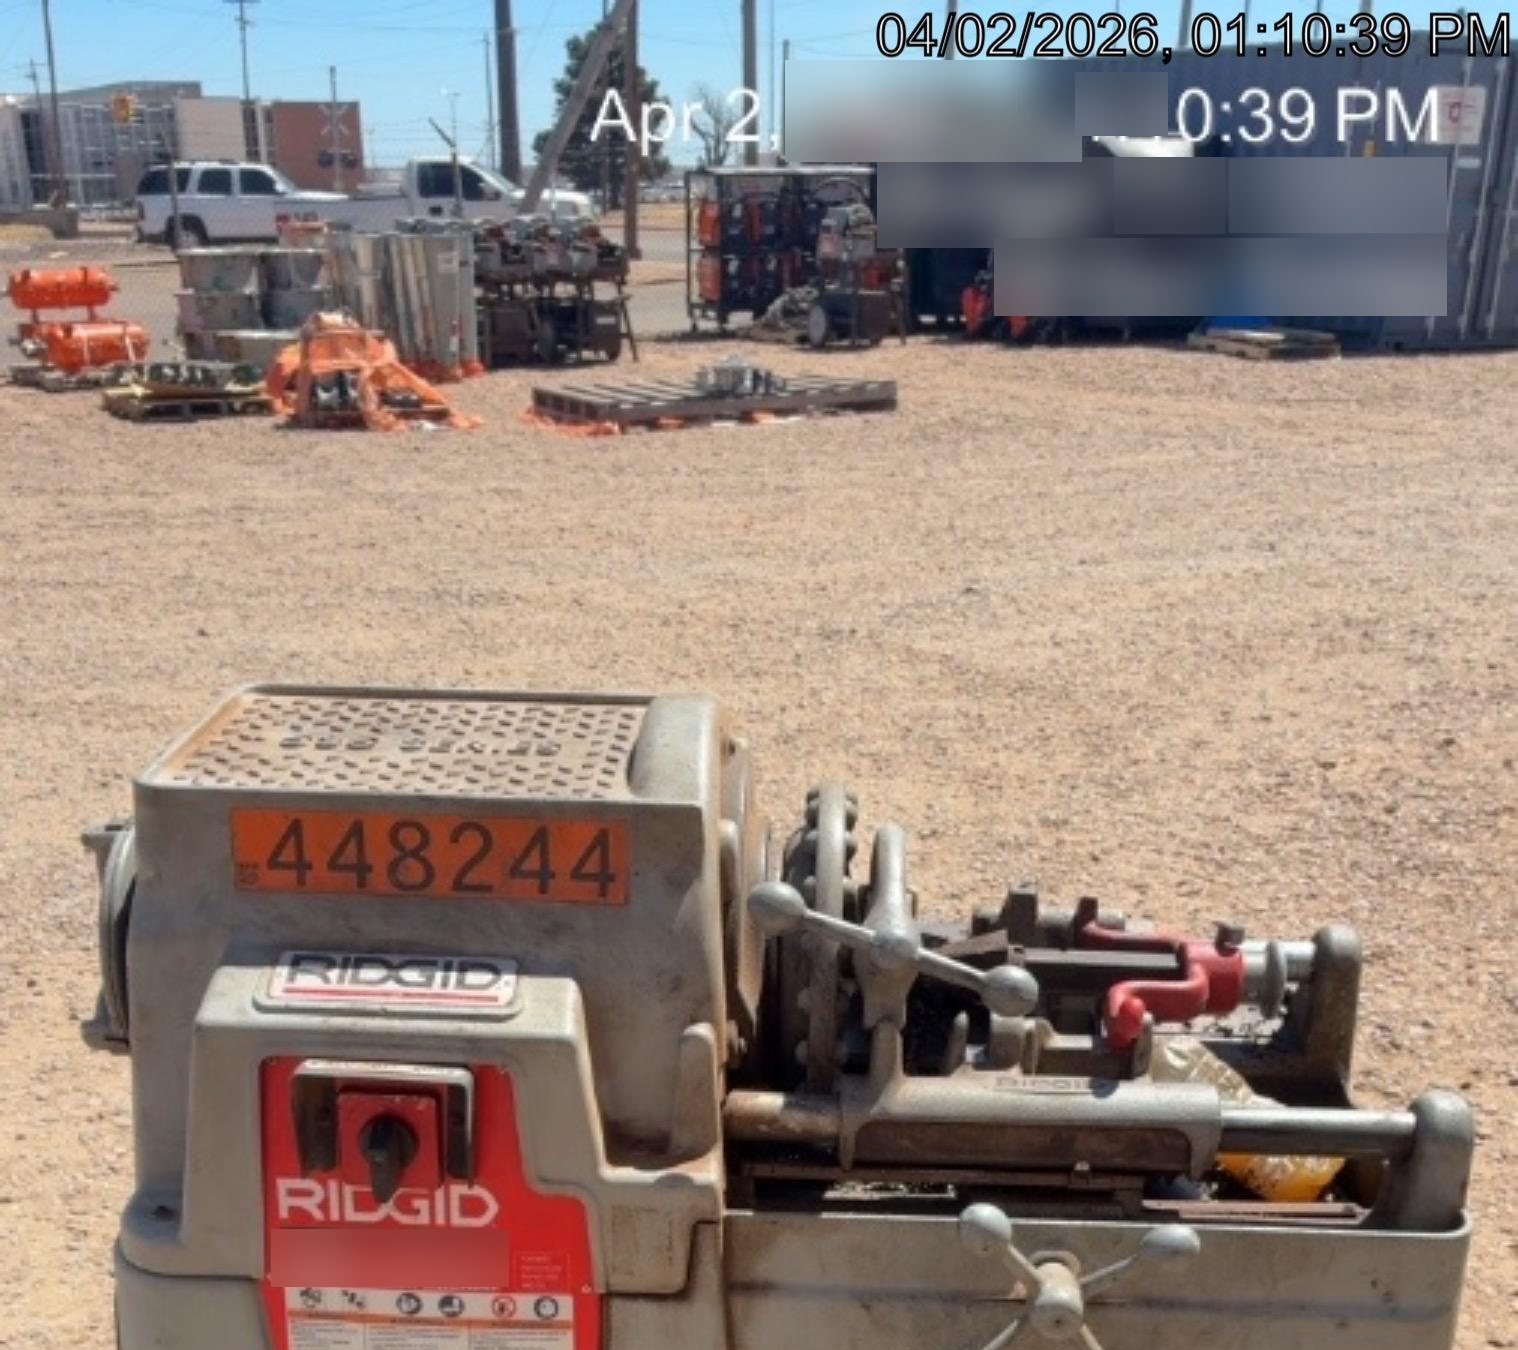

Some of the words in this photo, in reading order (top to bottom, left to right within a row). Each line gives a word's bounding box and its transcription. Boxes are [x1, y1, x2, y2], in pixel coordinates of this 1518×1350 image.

[266, 816, 616, 899] 448244
[286, 953, 502, 990] RIDGID
[275, 1177, 500, 1228] RIDGID
